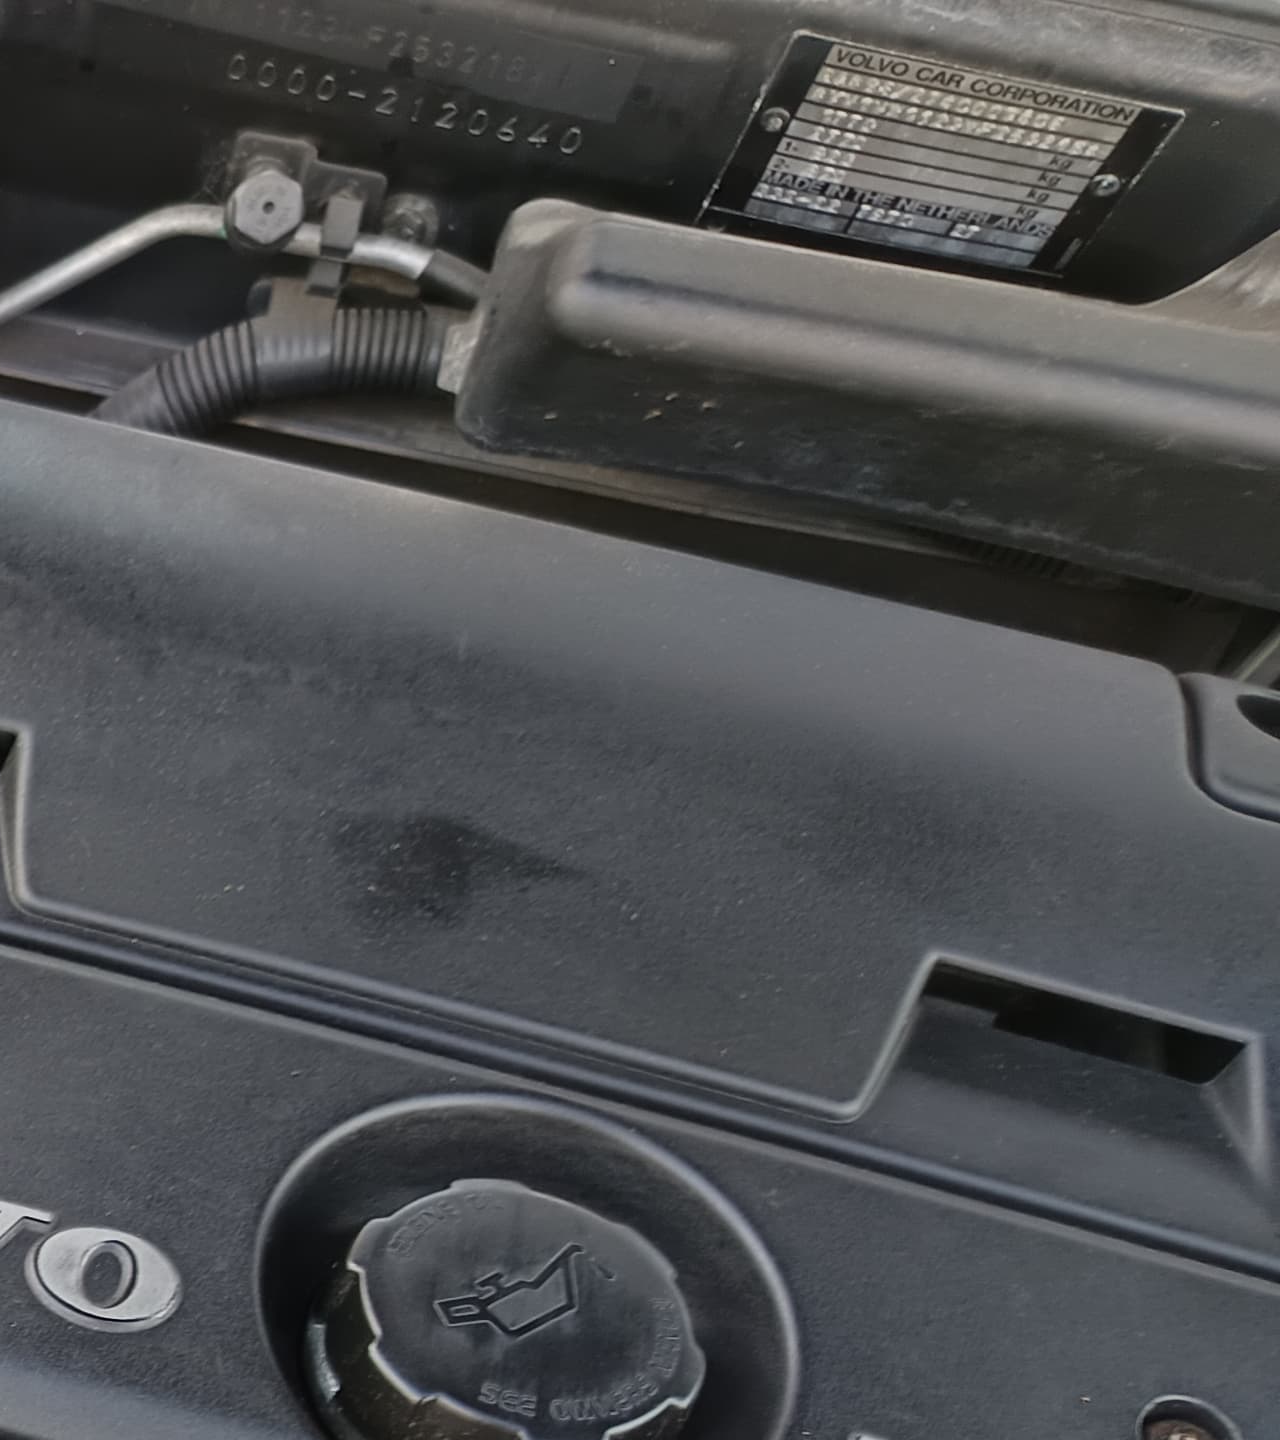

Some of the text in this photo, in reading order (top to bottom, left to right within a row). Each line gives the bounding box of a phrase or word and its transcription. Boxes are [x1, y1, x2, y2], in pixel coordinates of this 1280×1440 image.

[835, 48, 909, 77] VOLVO
[916, 68, 965, 89] CAR
[971, 75, 1135, 122] CORPORATION
[226, 52, 583, 155] 0000-2120640
[1049, 155, 1073, 172] kg
[1038, 171, 1061, 188] kg
[1026, 187, 1049, 204] kg
[761, 170, 824, 194] MADE
[826, 182, 849, 199] IN
[852, 187, 895, 208] THE
[895, 196, 1058, 239] NETHERLANDS
[1015, 204, 1038, 220] kg
